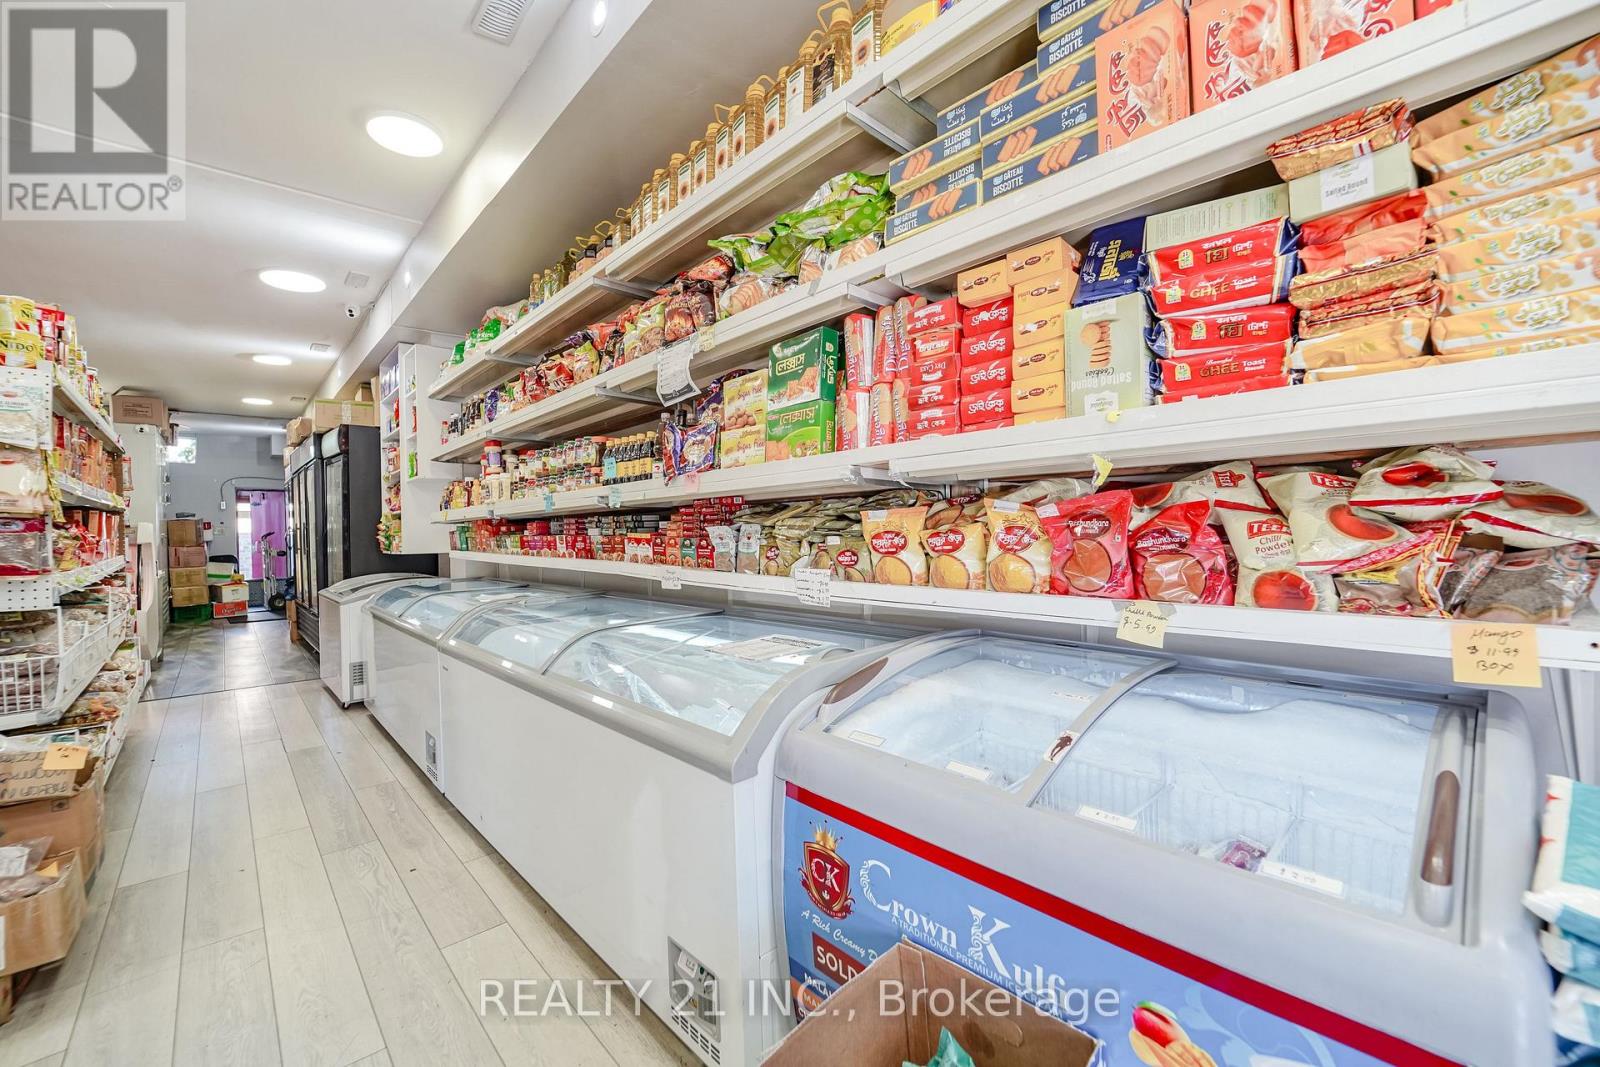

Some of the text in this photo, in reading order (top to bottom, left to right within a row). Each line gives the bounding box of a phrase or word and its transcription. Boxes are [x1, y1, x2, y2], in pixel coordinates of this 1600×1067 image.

[1048, 36, 1084, 65] BISCOTTE
[944, 127, 972, 149] BISCOTTE
[948, 163, 975, 183] BISCOTTE
[992, 175, 1024, 197] BISCOTTE
[1190, 282, 1231, 299] GHEE
[1199, 361, 1241, 377] GHEE
[1255, 540, 1291, 555] Powder
[860, 859, 957, 950] Crown
[899, 919, 955, 958] TRADITIONAL
[956, 951, 1003, 984] PREMIUM
